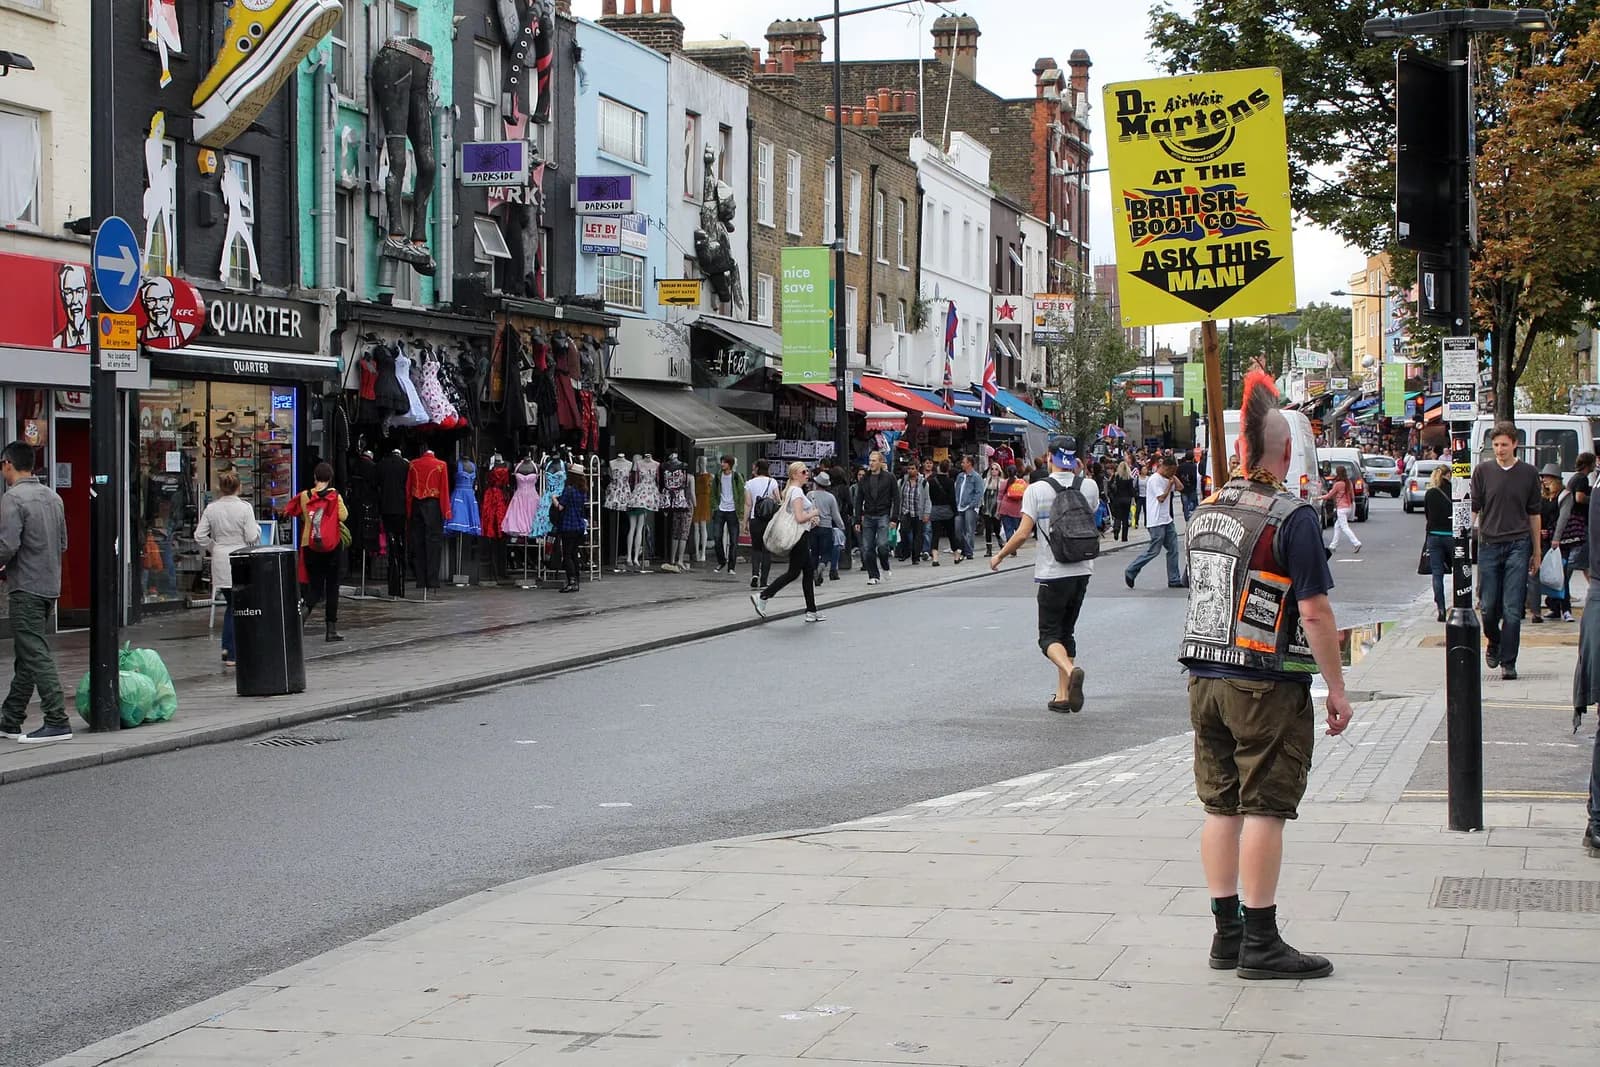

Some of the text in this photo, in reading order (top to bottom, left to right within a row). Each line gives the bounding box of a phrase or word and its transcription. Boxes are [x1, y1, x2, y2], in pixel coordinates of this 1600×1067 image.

[1115, 89, 1156, 116] Dr.
[1116, 88, 1271, 142] Martens
[471, 172, 514, 182] DARKSIDE
[1152, 162, 1246, 185] AT THE
[585, 201, 624, 211] DARKSIDE
[1130, 190, 1237, 220] BRITISH
[585, 223, 617, 234] LET BY
[1131, 212, 1237, 239] BOOT CO
[1140, 240, 1271, 271] ASK THIS
[783, 266, 810, 278] nice
[1167, 264, 1246, 292] MAN!
[783, 283, 814, 293] save
[175, 309, 195, 317] KFC
[210, 300, 303, 338] QUARTER
[233, 360, 270, 374] QUARTER
[202, 436, 252, 459] SALE
